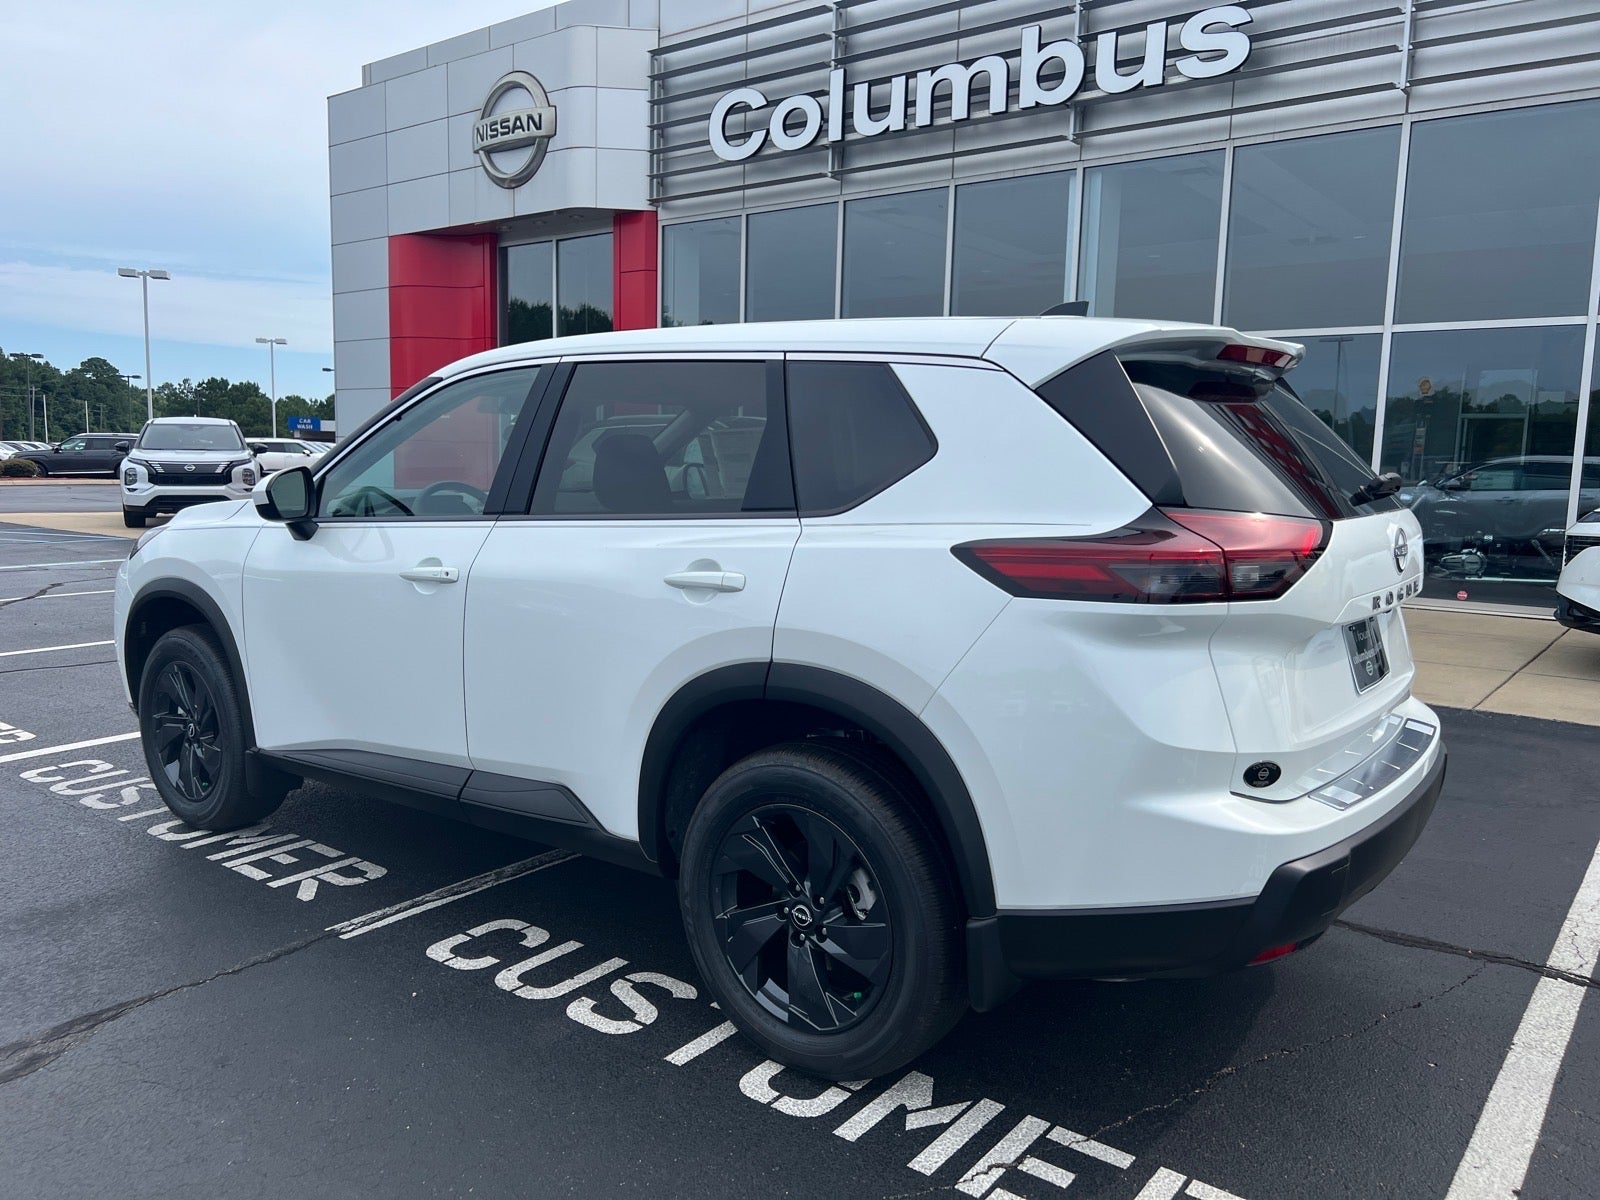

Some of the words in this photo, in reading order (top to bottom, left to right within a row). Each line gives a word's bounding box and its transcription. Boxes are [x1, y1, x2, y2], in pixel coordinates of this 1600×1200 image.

[475, 112, 542, 145] NISSAN
[707, 4, 1253, 163] Columbus
[1372, 582, 1419, 610] ROGUE
[425, 918, 1247, 1200] CUSOME
